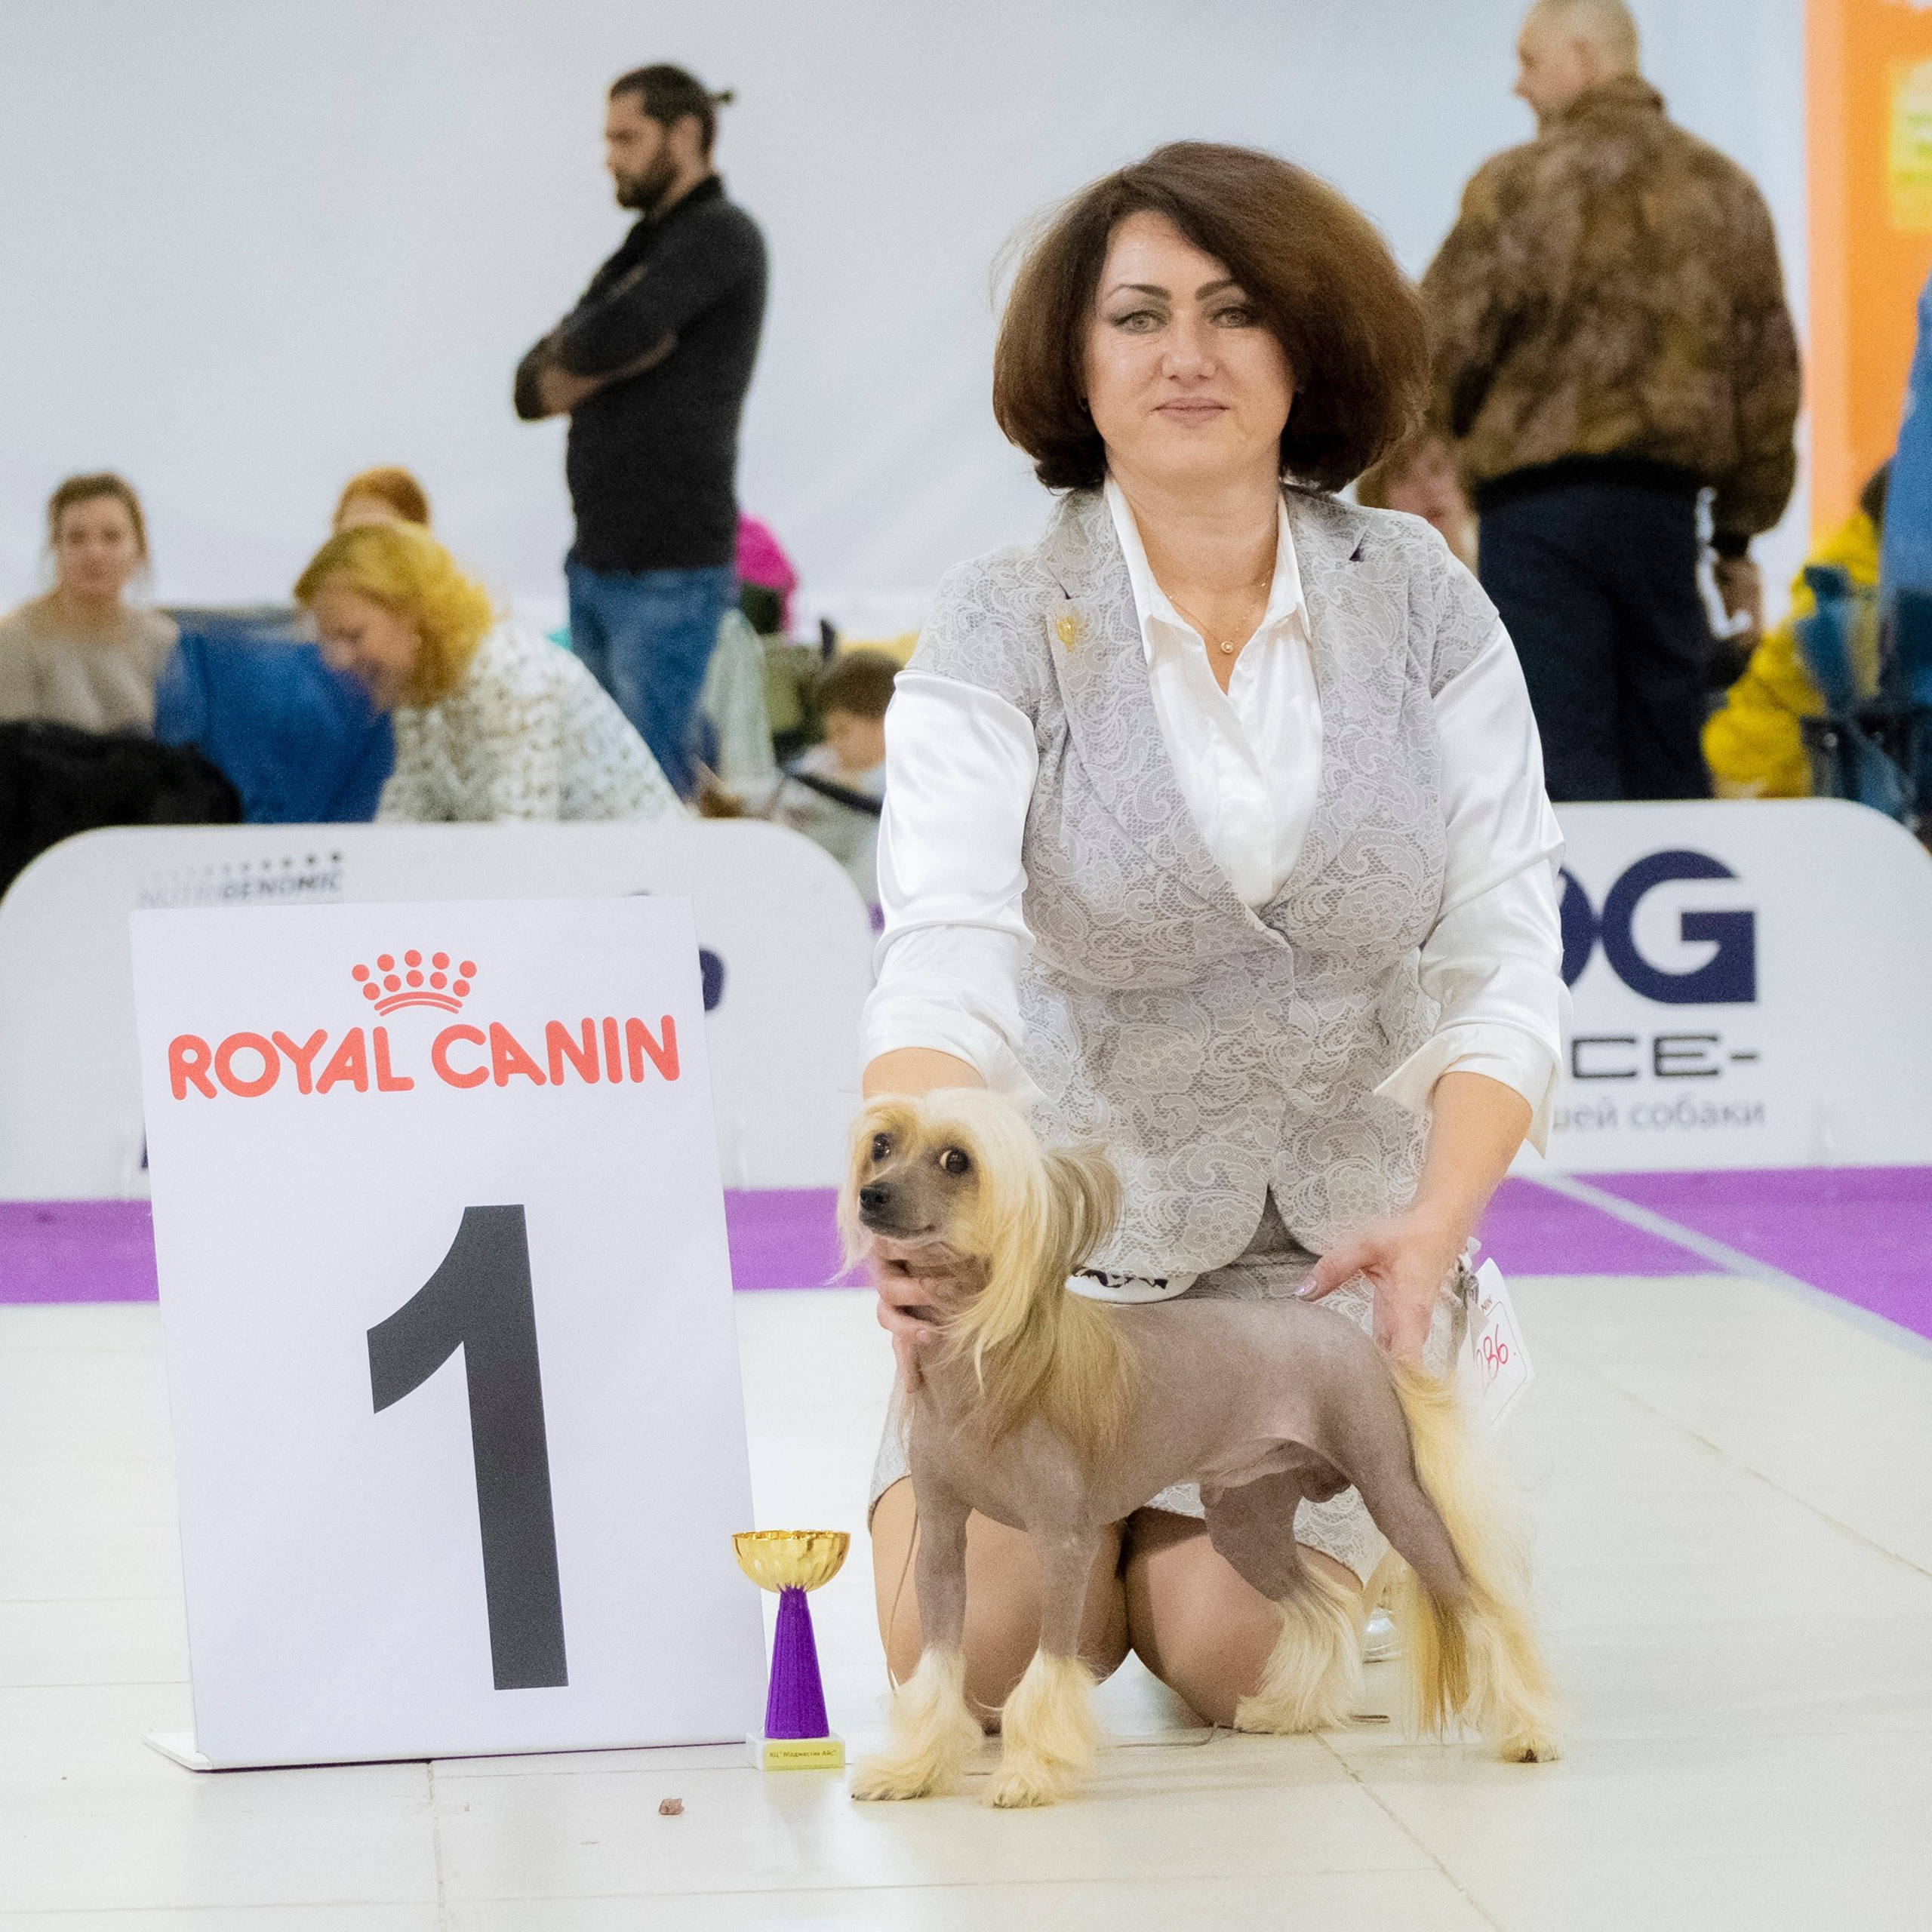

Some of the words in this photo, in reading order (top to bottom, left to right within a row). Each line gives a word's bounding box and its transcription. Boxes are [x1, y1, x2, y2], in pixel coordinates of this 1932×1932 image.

[1558, 849, 1757, 1004] G
[168, 1026, 414, 1101] ROYAL
[431, 1014, 681, 1090] CANIN
[1627, 1091, 1765, 1131] собаки
[366, 1204, 569, 1690] 1
